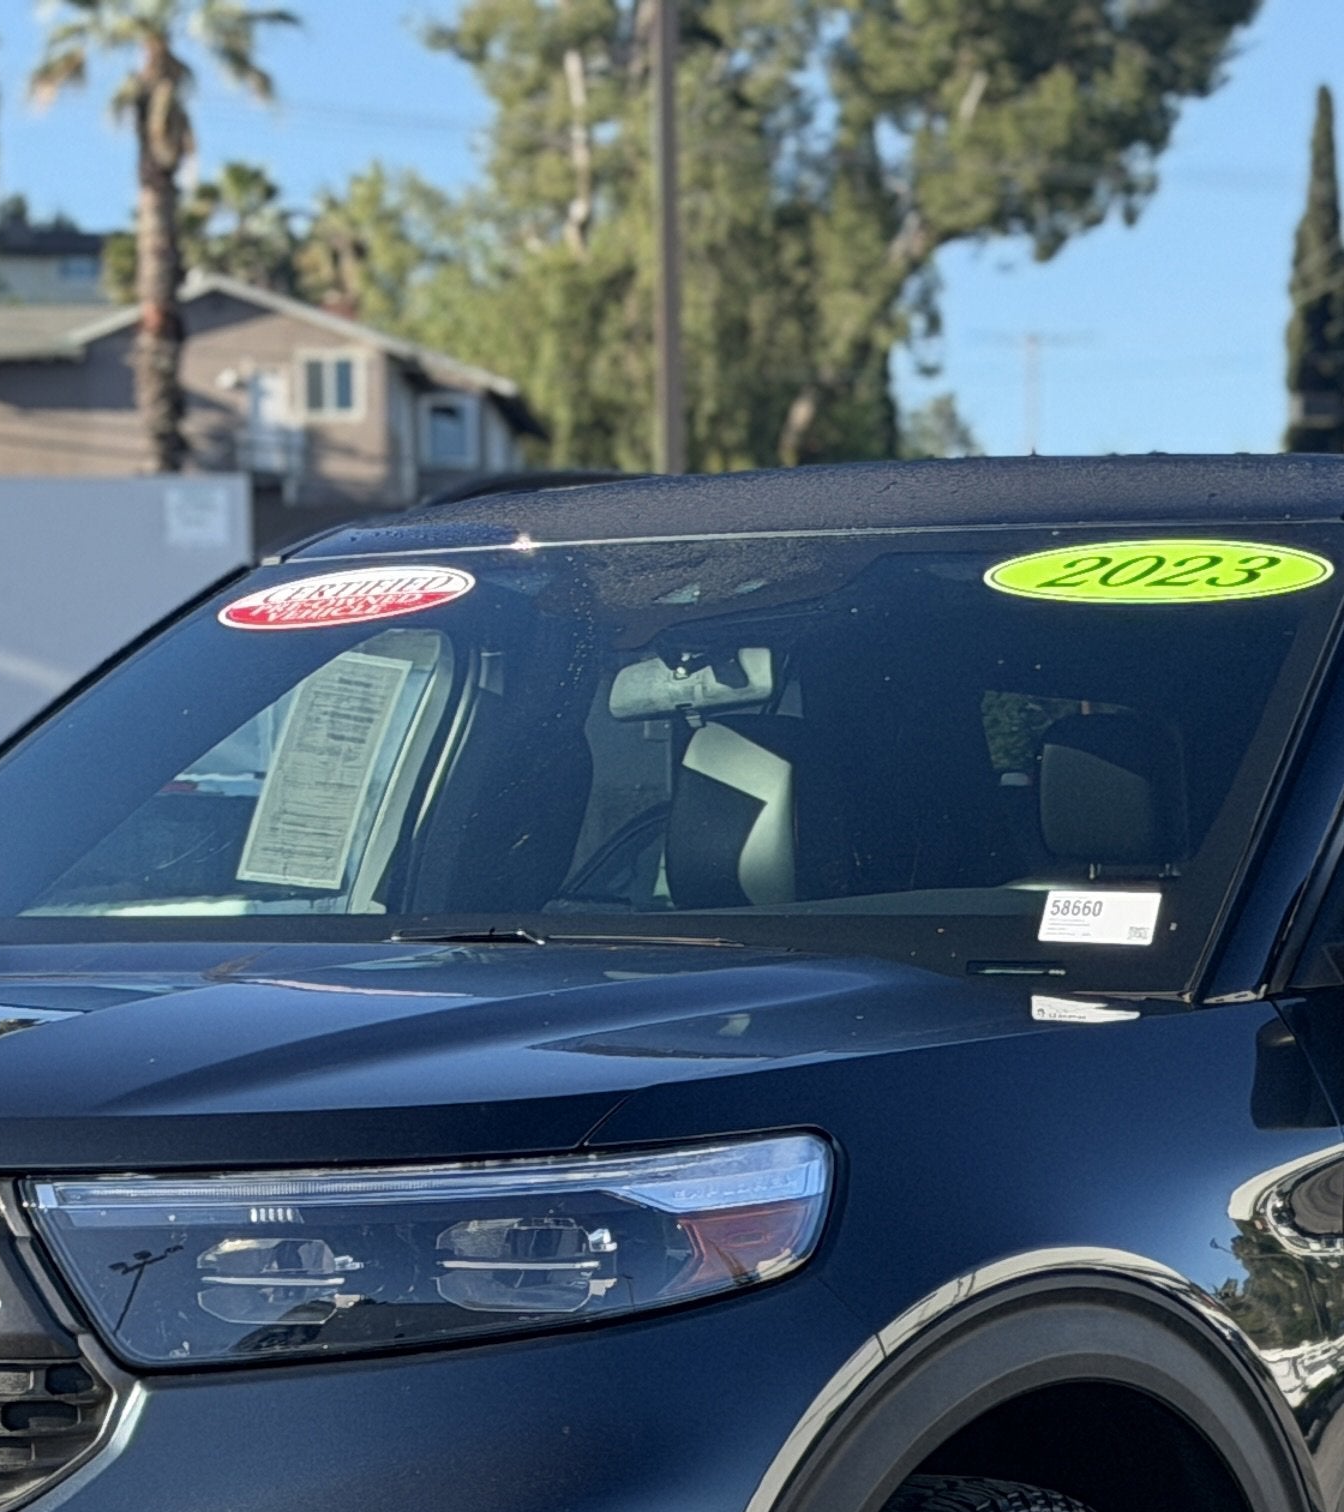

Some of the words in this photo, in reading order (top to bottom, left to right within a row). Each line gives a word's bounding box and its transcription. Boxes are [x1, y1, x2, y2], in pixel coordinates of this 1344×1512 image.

[1035, 555, 1283, 588] 2023
[263, 576, 453, 603] CERTIFIED
[266, 603, 386, 622] VEHICLE
[1050, 900, 1104, 917] 58660
